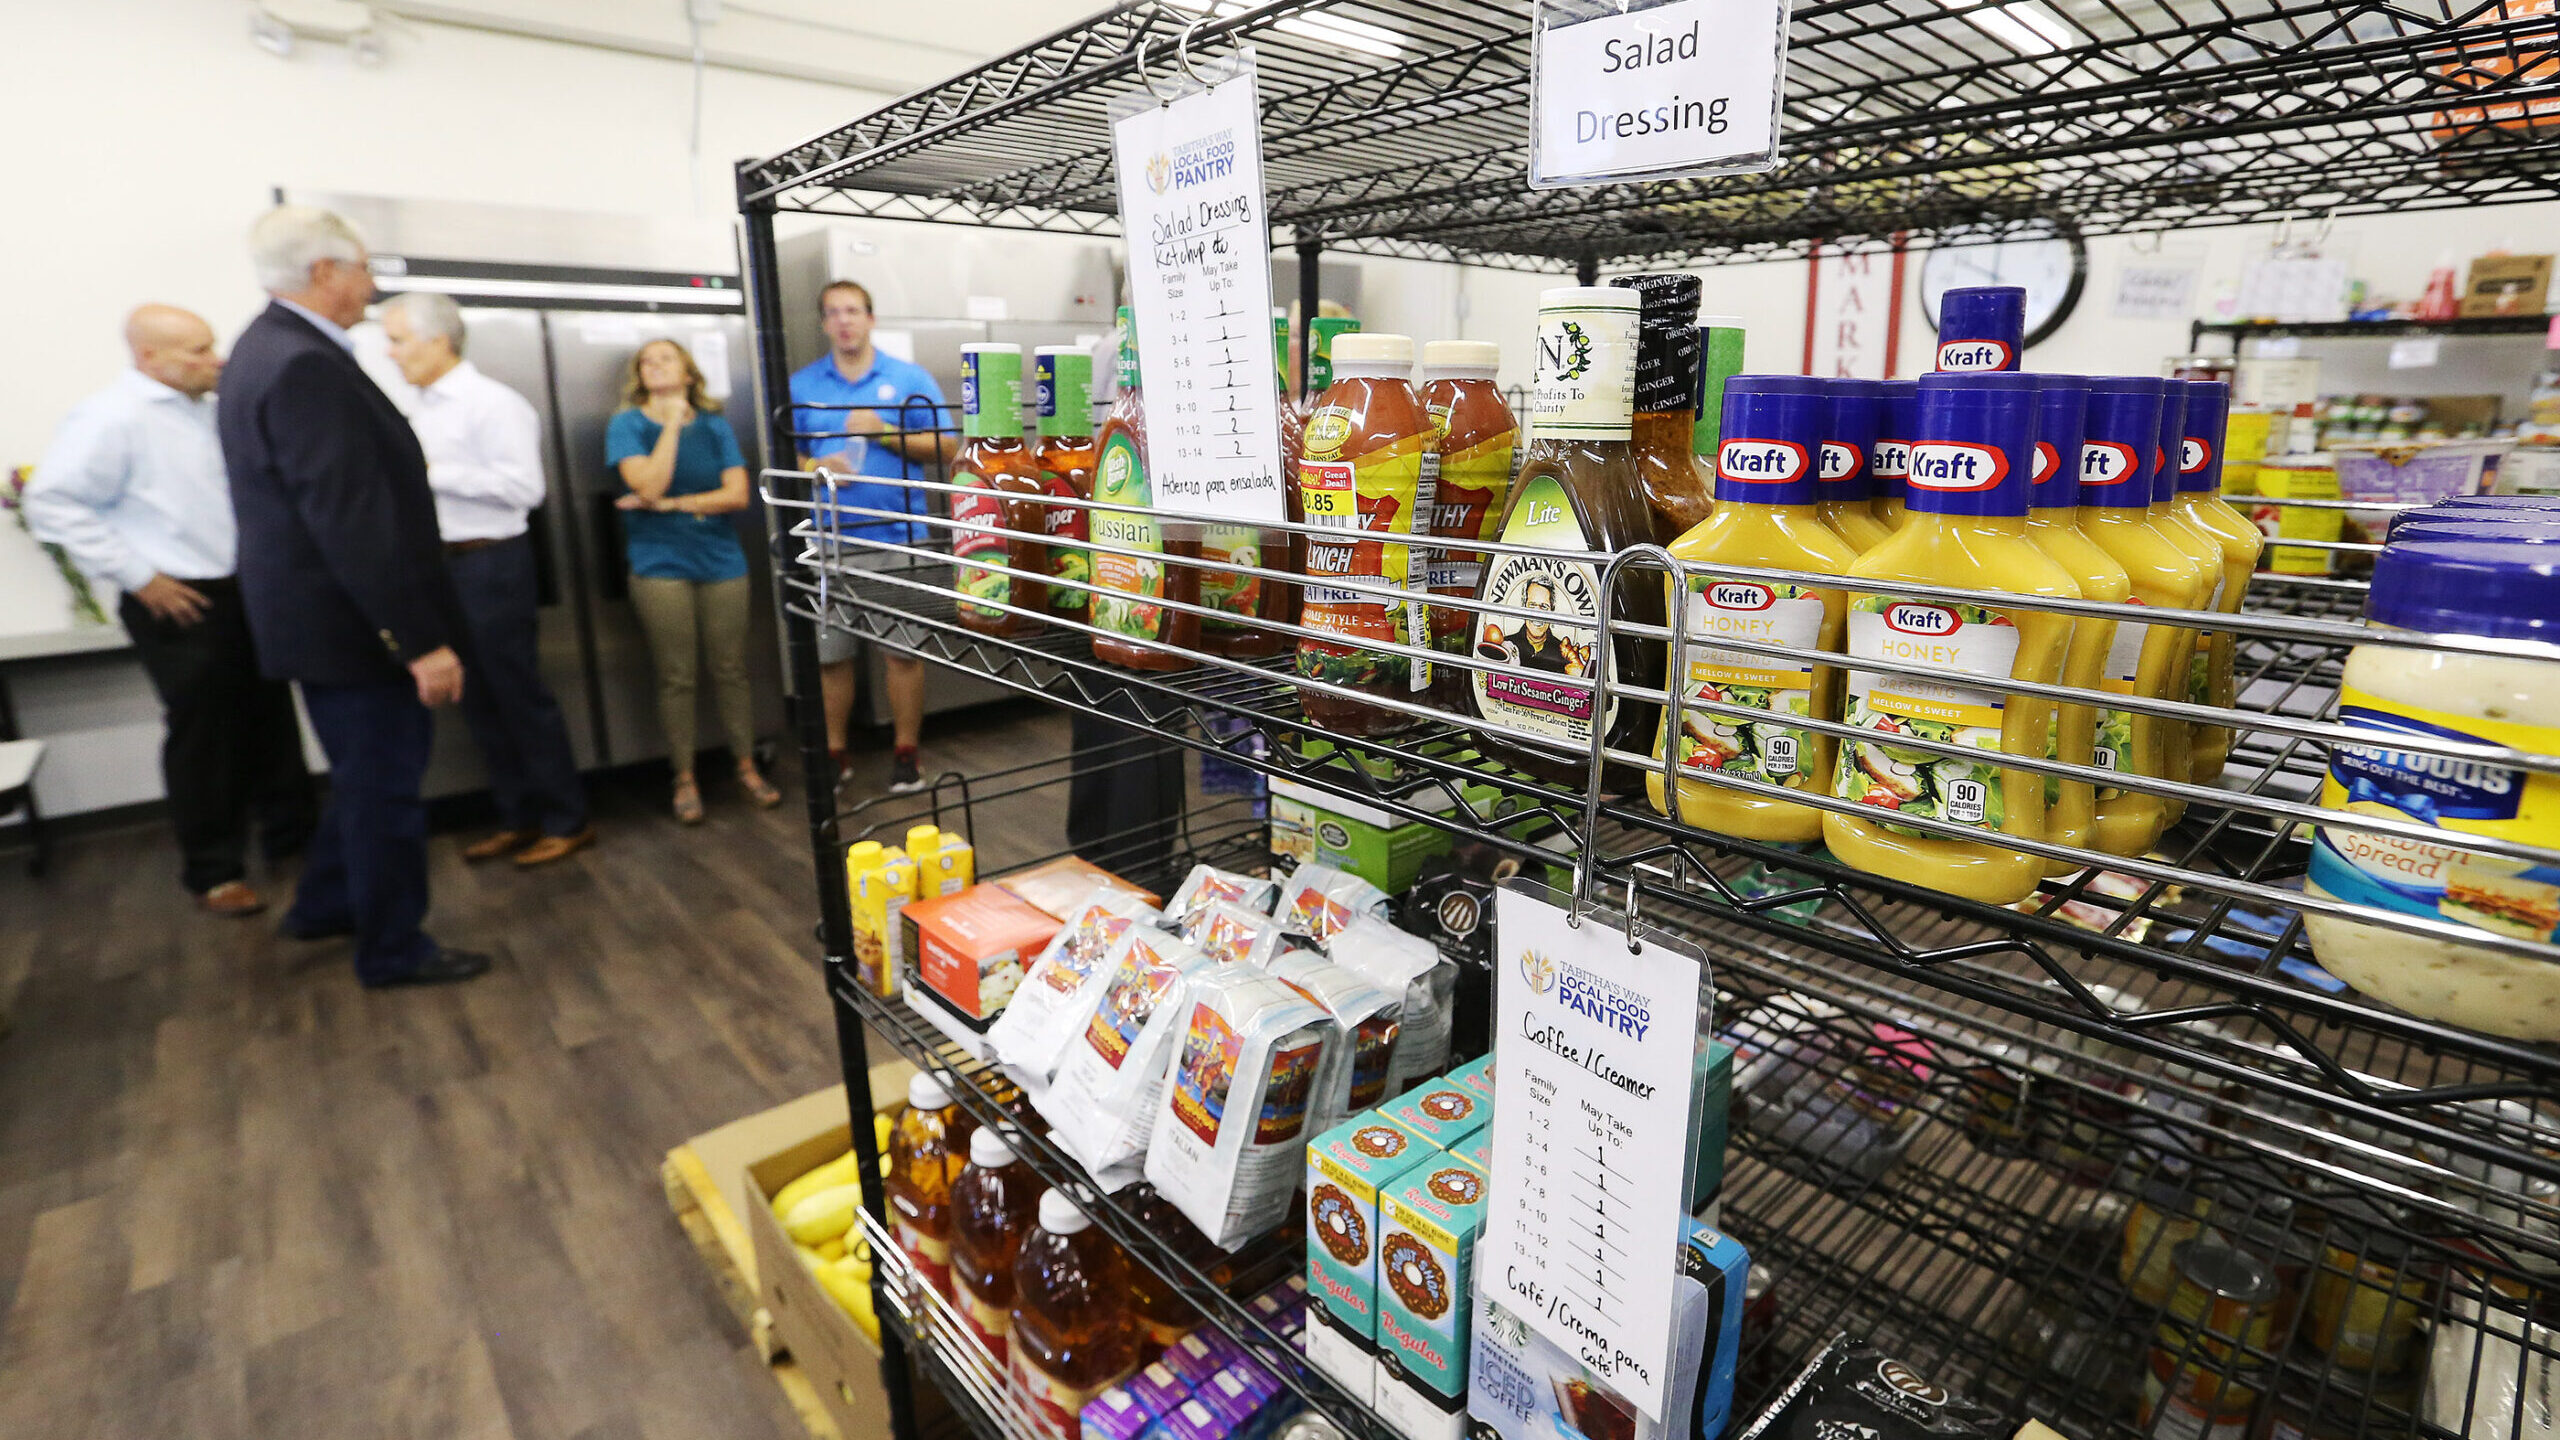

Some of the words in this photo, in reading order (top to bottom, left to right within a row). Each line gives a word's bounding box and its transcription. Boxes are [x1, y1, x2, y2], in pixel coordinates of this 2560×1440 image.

[1603, 20, 1699, 73] Salad
[1577, 95, 1730, 145] Dressing
[1215, 128, 1234, 142] WAY
[1173, 151, 1203, 170] LOCAL
[1206, 141, 1235, 159] FOOD
[1175, 154, 1235, 190] PANTRY
[1152, 204, 1192, 245] Salad
[1200, 195, 1251, 228] Dressing
[1154, 238, 1205, 269] Ketchup
[1162, 270, 1186, 285] Family
[1202, 264, 1218, 278] May
[1220, 259, 1238, 274] Take
[1168, 289, 1184, 299] Size
[1209, 280, 1220, 293] Up
[1181, 311, 1186, 320] 2
[1220, 300, 1227, 316] 1
[1183, 334, 1188, 344] 4
[1222, 326, 1228, 340] 1
[1185, 356, 1190, 366] 6
[1225, 347, 1232, 363] 1
[1944, 346, 1992, 366] Kraft
[1187, 379, 1192, 389] 8
[1227, 370, 1233, 387] 2
[1637, 375, 1675, 392] GINGER
[1229, 395, 1235, 411] 2
[1537, 388, 1567, 402] Profits
[1570, 388, 1585, 400] To
[1652, 392, 1687, 411] GINGER
[1187, 403, 1197, 412] 10
[1534, 402, 1566, 417] Charity
[1192, 425, 1200, 434] 12
[1231, 417, 1238, 433] 2
[1194, 448, 1202, 457] 14
[1234, 440, 1242, 455] 2
[1727, 448, 1787, 473] Kraft
[1913, 451, 1977, 480] Kraft
[1162, 473, 1199, 496] Aderezo
[1206, 479, 1227, 502] para
[1230, 464, 1276, 491] ensalada
[1324, 471, 1347, 479] Great
[1325, 480, 1347, 488] Deal!
[1301, 490, 1334, 512] 0.85
[1526, 501, 1561, 527] Lite
[1092, 511, 1150, 543] Russian
[1306, 543, 1354, 573] LYNCH
[1717, 588, 1758, 605] Kraft
[1325, 612, 1359, 626] STYLE
[1703, 615, 1775, 635] HONEY
[1898, 608, 1942, 629] Kraft
[1882, 639, 1960, 664] HONEY
[1695, 669, 1732, 680] MELLOW
[1743, 673, 1776, 683] SWEET
[1492, 674, 1508, 690] Low
[1508, 679, 1520, 695] Fat
[1521, 681, 1552, 702] Sesame
[1552, 689, 1584, 712] Ginger
[1878, 676, 1957, 699] DRESSING
[1873, 697, 1912, 712] MELLOW
[1914, 704, 1922, 712] &
[1924, 706, 1962, 718] SWEET
[1545, 714, 1567, 728] Calories
[1773, 740, 1790, 755] 90
[1768, 754, 1795, 764] CALORIES
[2369, 763, 2394, 779] OUT
[2396, 771, 2420, 787] THE
[1956, 784, 1977, 802] 90
[1950, 800, 1982, 811] CALORIES
[2344, 834, 2441, 879] Spread
[1560, 960, 1621, 995] TABITHA'S
[1623, 987, 1651, 1009] WAY
[1560, 973, 1604, 1002] LOCAL
[1608, 993, 1651, 1023] FOOD
[1559, 986, 1649, 1042] PANTRY
[1524, 1068, 1558, 1096] Family
[1529, 1087, 1551, 1107] Size
[1400, 1106, 1440, 1134] Regular
[1528, 1111, 1533, 1121] 1
[1543, 1120, 1550, 1131] 2
[1581, 1099, 1603, 1122] May
[1606, 1112, 1633, 1138] Take
[1527, 1133, 1533, 1144] 3
[1542, 1142, 1549, 1153] 4
[1588, 1119, 1603, 1138] Up
[1607, 1130, 1624, 1150] To:
[1329, 1141, 1371, 1172] Regular
[1525, 1156, 1531, 1167] 5
[1540, 1165, 1547, 1176] 6
[1598, 1146, 1606, 1167] 1
[1524, 1178, 1530, 1188] 7
[1539, 1187, 1546, 1199] 8
[1598, 1173, 1607, 1191] 1
[1404, 1187, 1452, 1221] Regular
[1519, 1199, 1526, 1210] 9
[1536, 1210, 1547, 1223] 10
[1596, 1200, 1605, 1216] 1
[1516, 1220, 1527, 1233] 11
[1537, 1235, 1548, 1248] 12
[1595, 1224, 1605, 1239] 1
[1514, 1242, 1525, 1255] 13
[1535, 1256, 1546, 1269] 14
[1595, 1248, 1604, 1263] 1
[1311, 1260, 1369, 1315] Regular
[1418, 1259, 1440, 1301] SHOP
[1596, 1269, 1605, 1286] 1
[1595, 1297, 1602, 1312] 1
[1507, 1265, 1544, 1307] Café
[1559, 1302, 1608, 1351] Crema
[1616, 1350, 1650, 1386] para
[1381, 1310, 1448, 1371] Regular
[1480, 1351, 1535, 1410] ICED
[1478, 1375, 1533, 1426] COFFEE
[1900, 1400, 1929, 1419] CLAW
